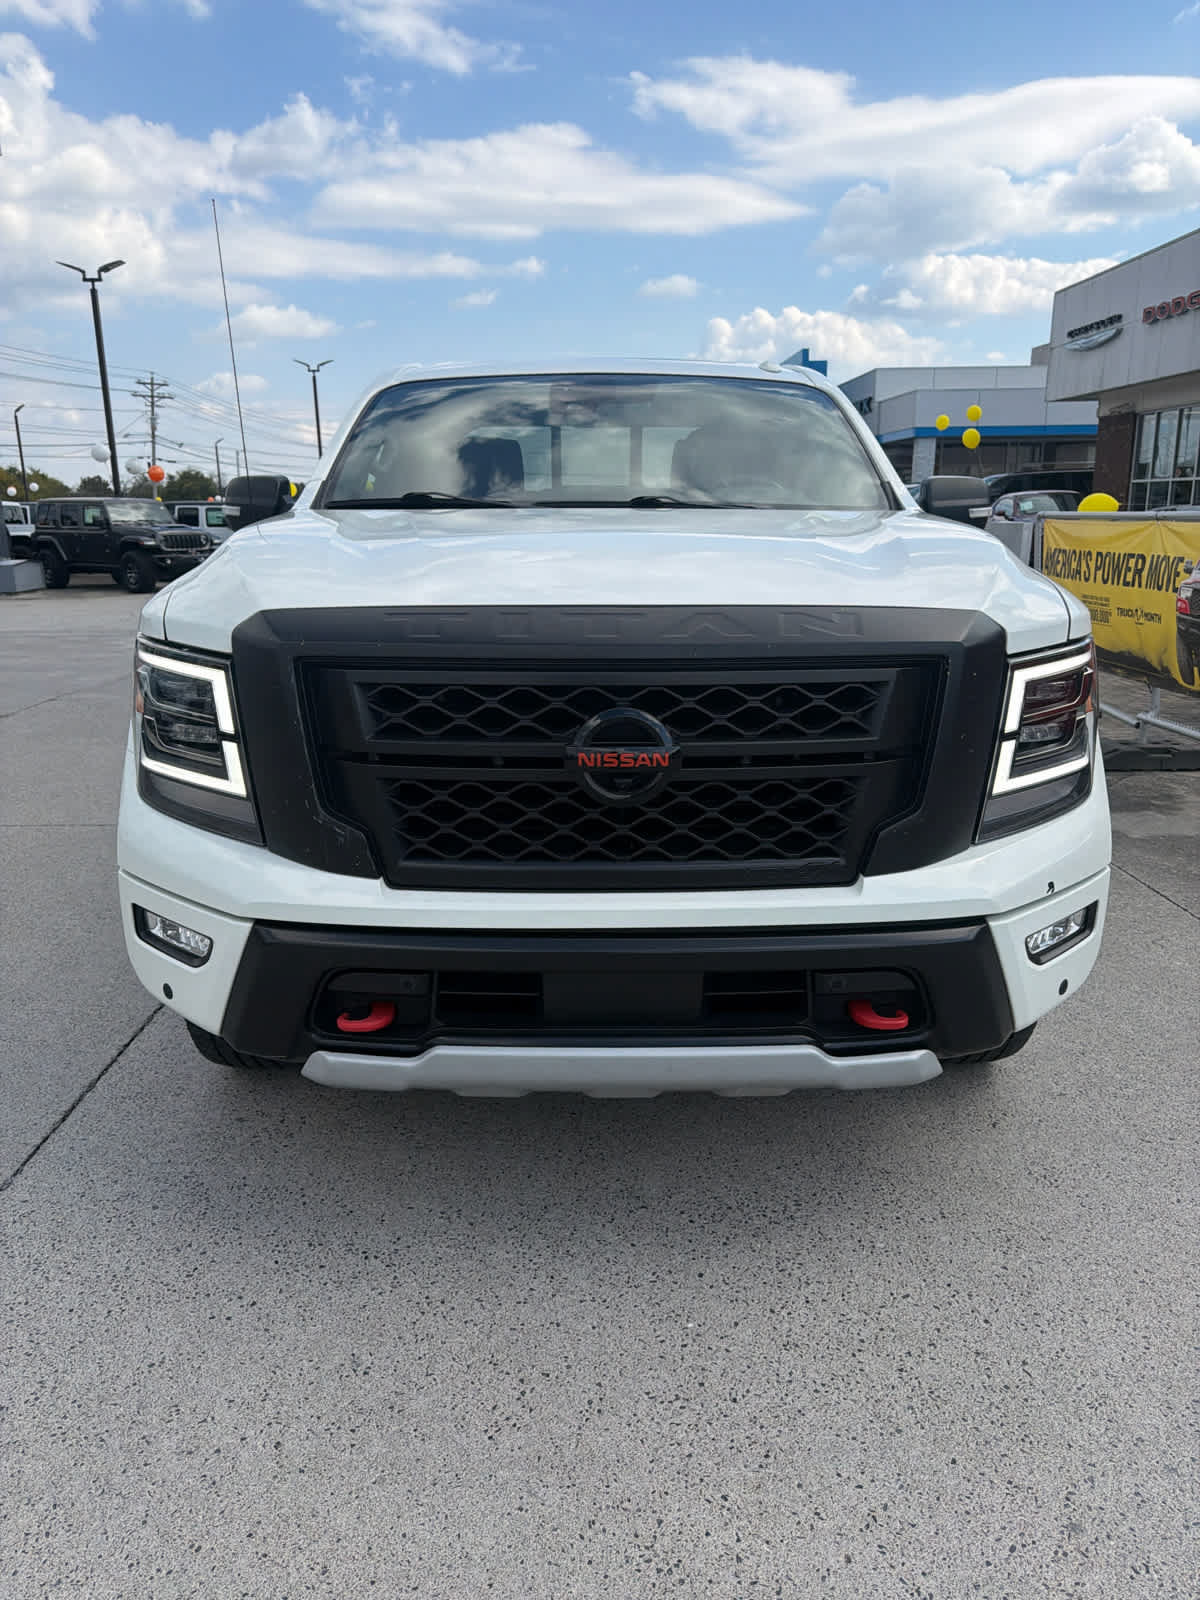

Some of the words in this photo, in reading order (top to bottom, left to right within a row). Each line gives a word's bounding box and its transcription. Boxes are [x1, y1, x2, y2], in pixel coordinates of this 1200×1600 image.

[1044, 547, 1092, 583] AMERICA'S
[1094, 552, 1146, 588] POWER
[1145, 553, 1185, 593] MOVE
[384, 609, 863, 639] TITAN
[577, 752, 669, 767] NISSAN
